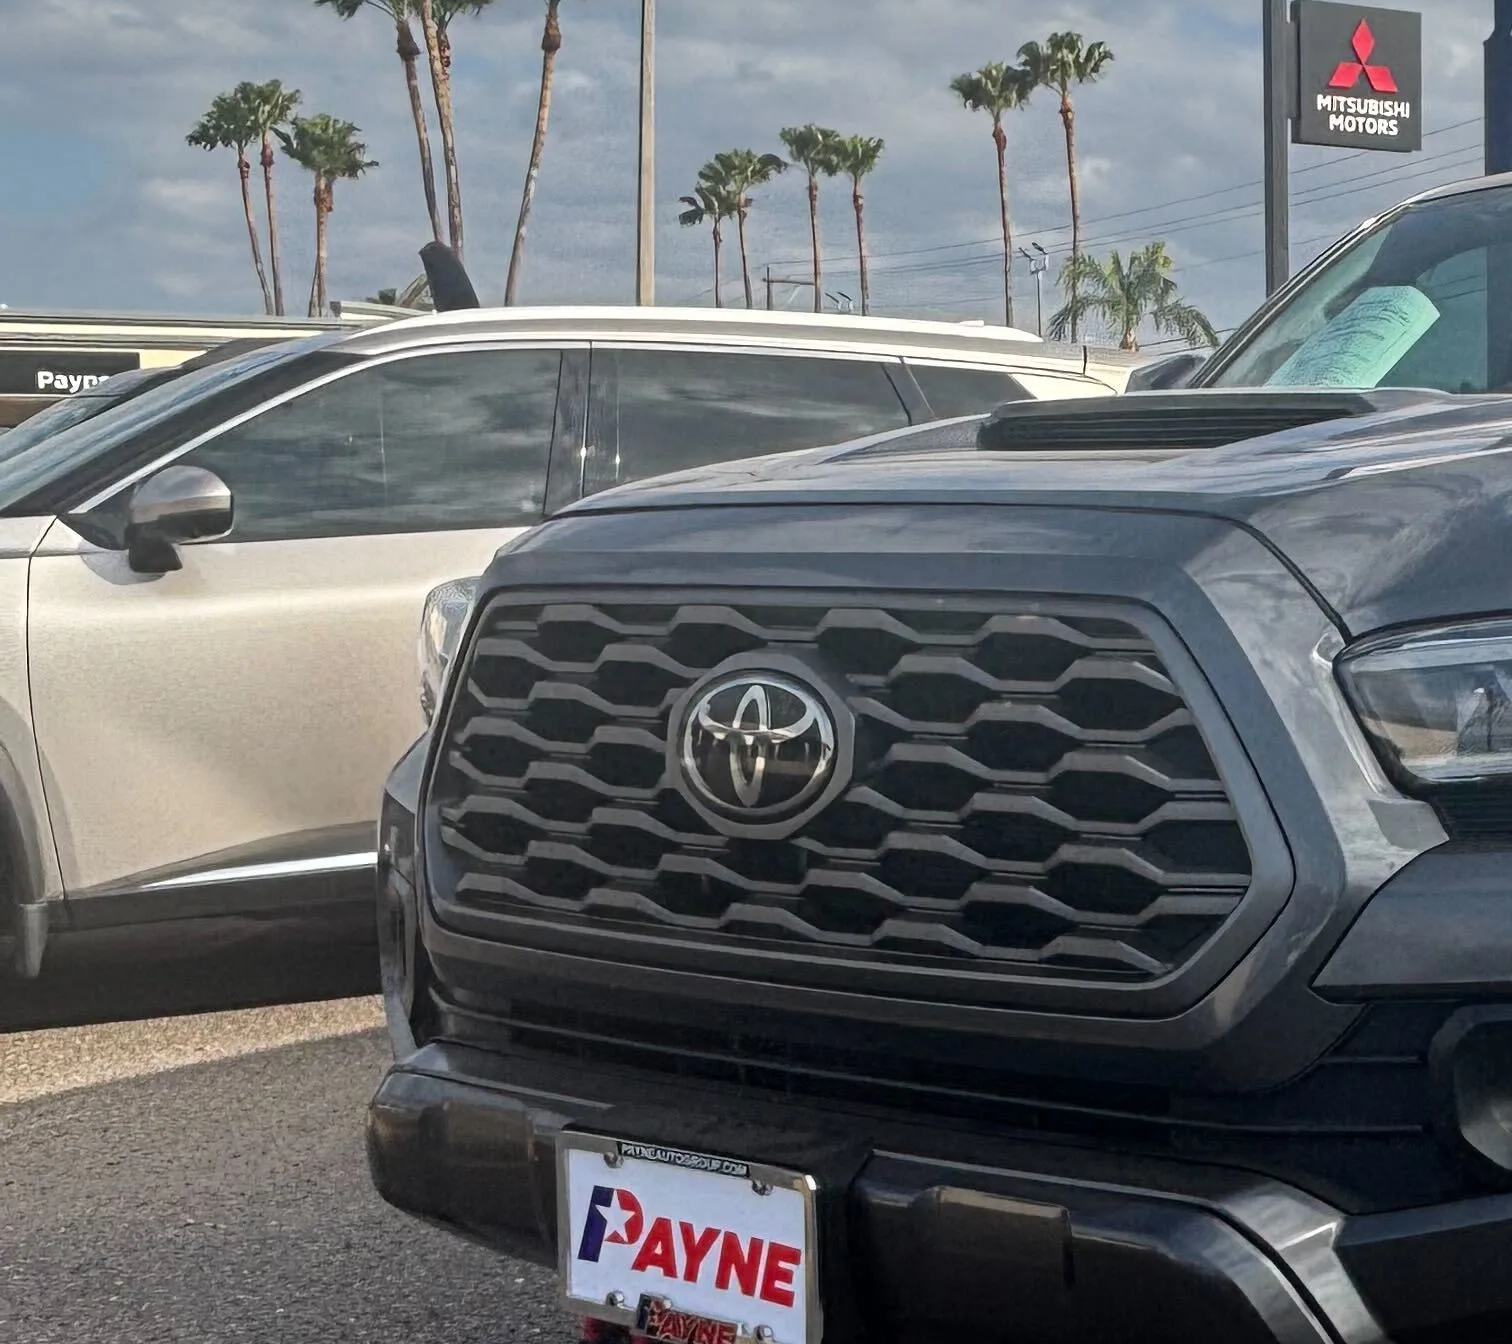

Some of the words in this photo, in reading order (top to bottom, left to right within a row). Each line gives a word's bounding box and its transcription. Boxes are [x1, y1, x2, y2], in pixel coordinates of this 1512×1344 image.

[1316, 93, 1411, 118] MITSUBISHI
[1328, 113, 1399, 137] MOTORS
[577, 1184, 802, 1308] PAYNE
